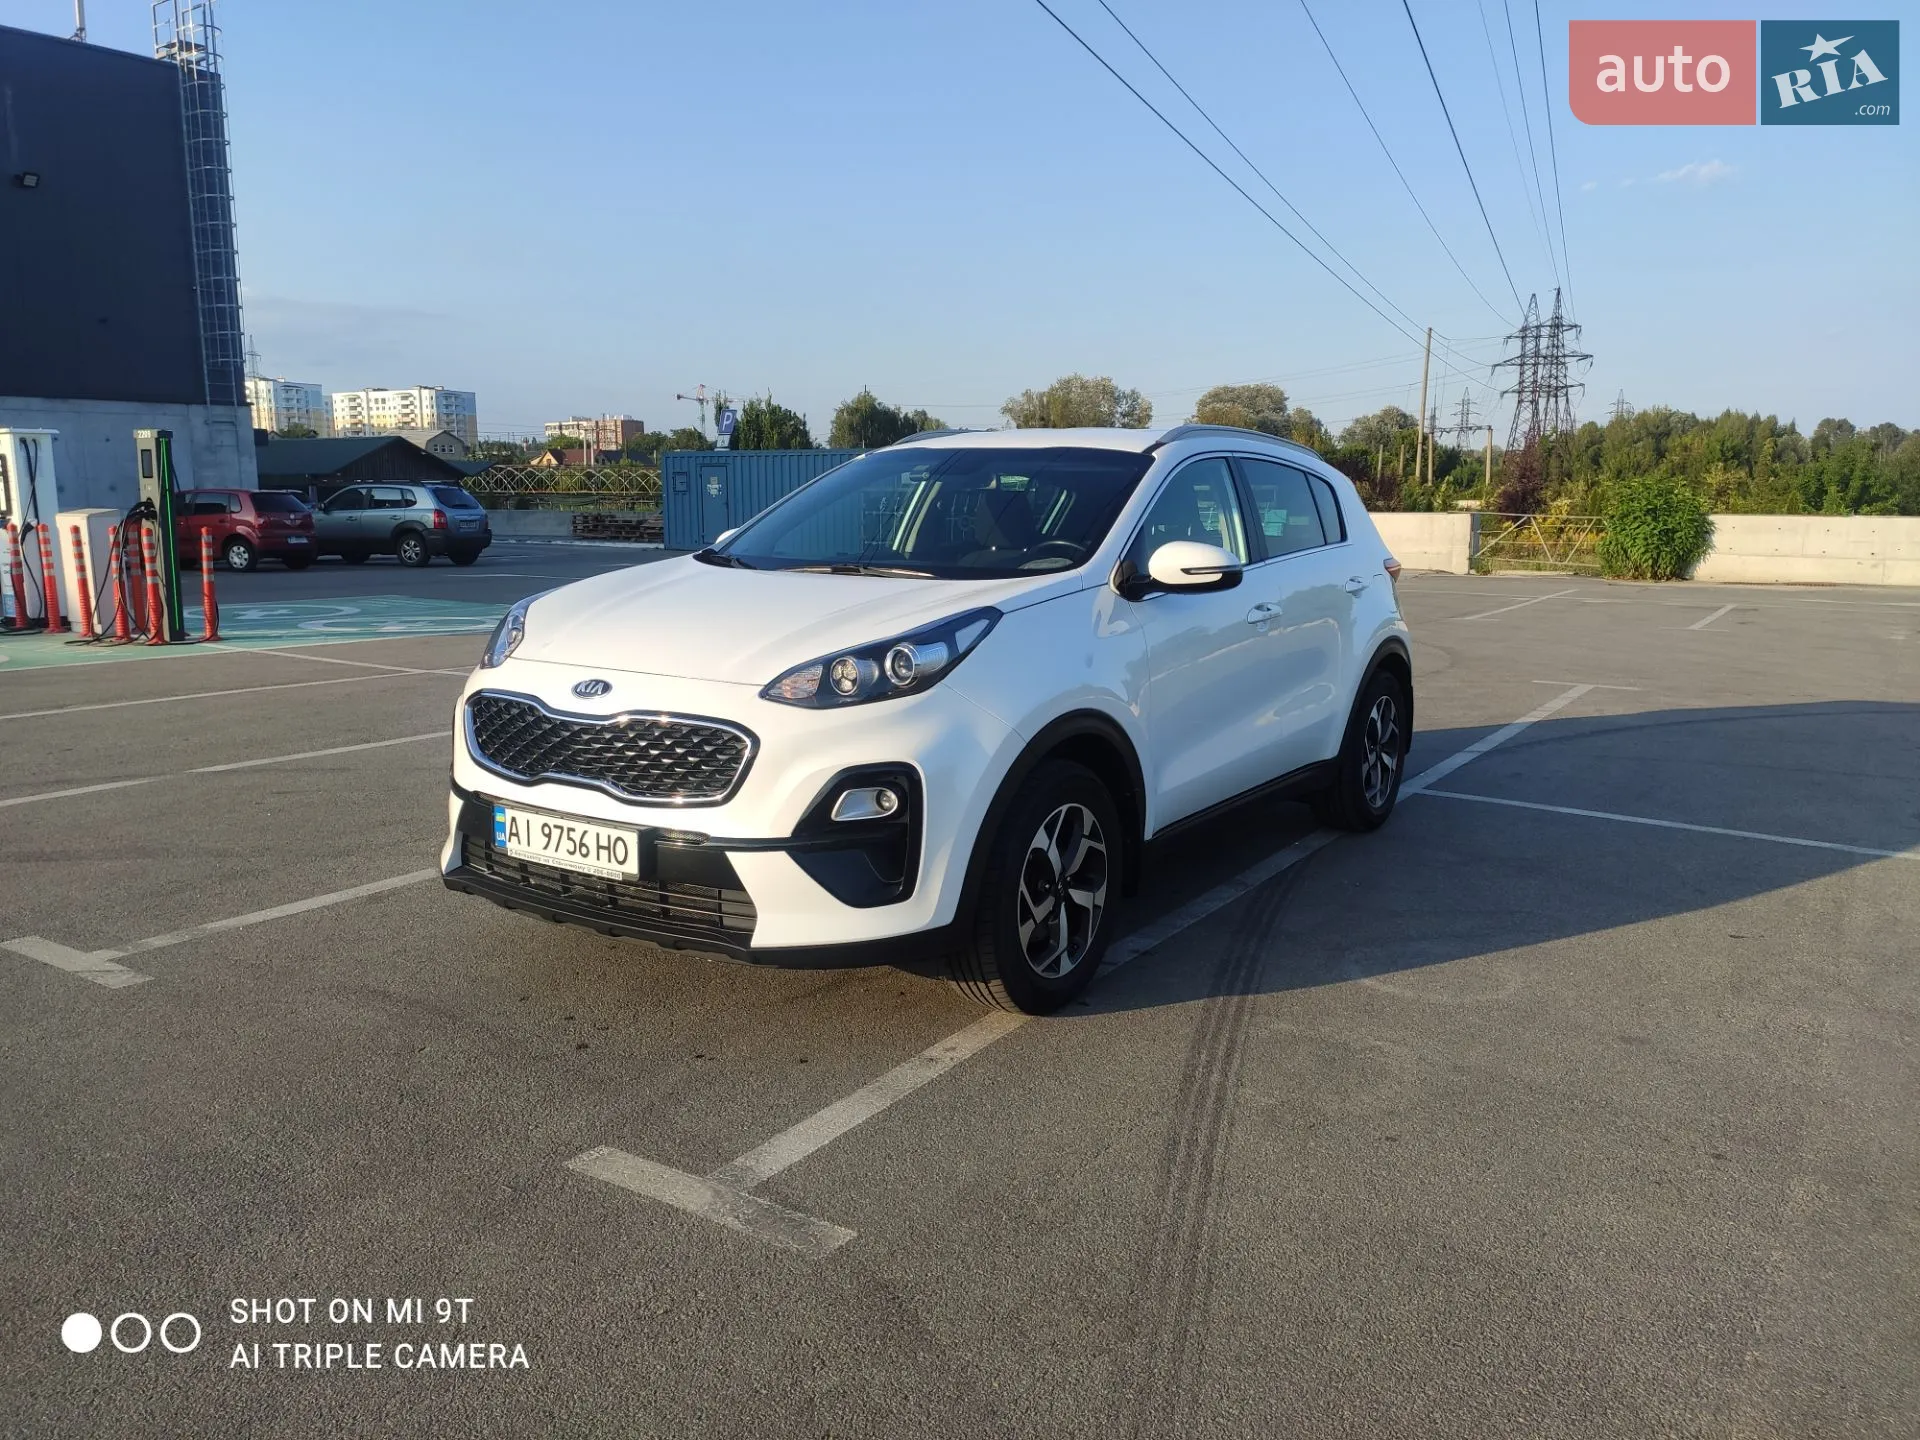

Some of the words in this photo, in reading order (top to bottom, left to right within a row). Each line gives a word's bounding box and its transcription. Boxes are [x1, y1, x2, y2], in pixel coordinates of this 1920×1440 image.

[722, 411, 733, 431] P
[575, 680, 606, 695] KIA
[495, 831, 506, 841] UA
[507, 816, 531, 847] AI
[541, 822, 590, 858] 9756
[596, 831, 629, 866] HO
